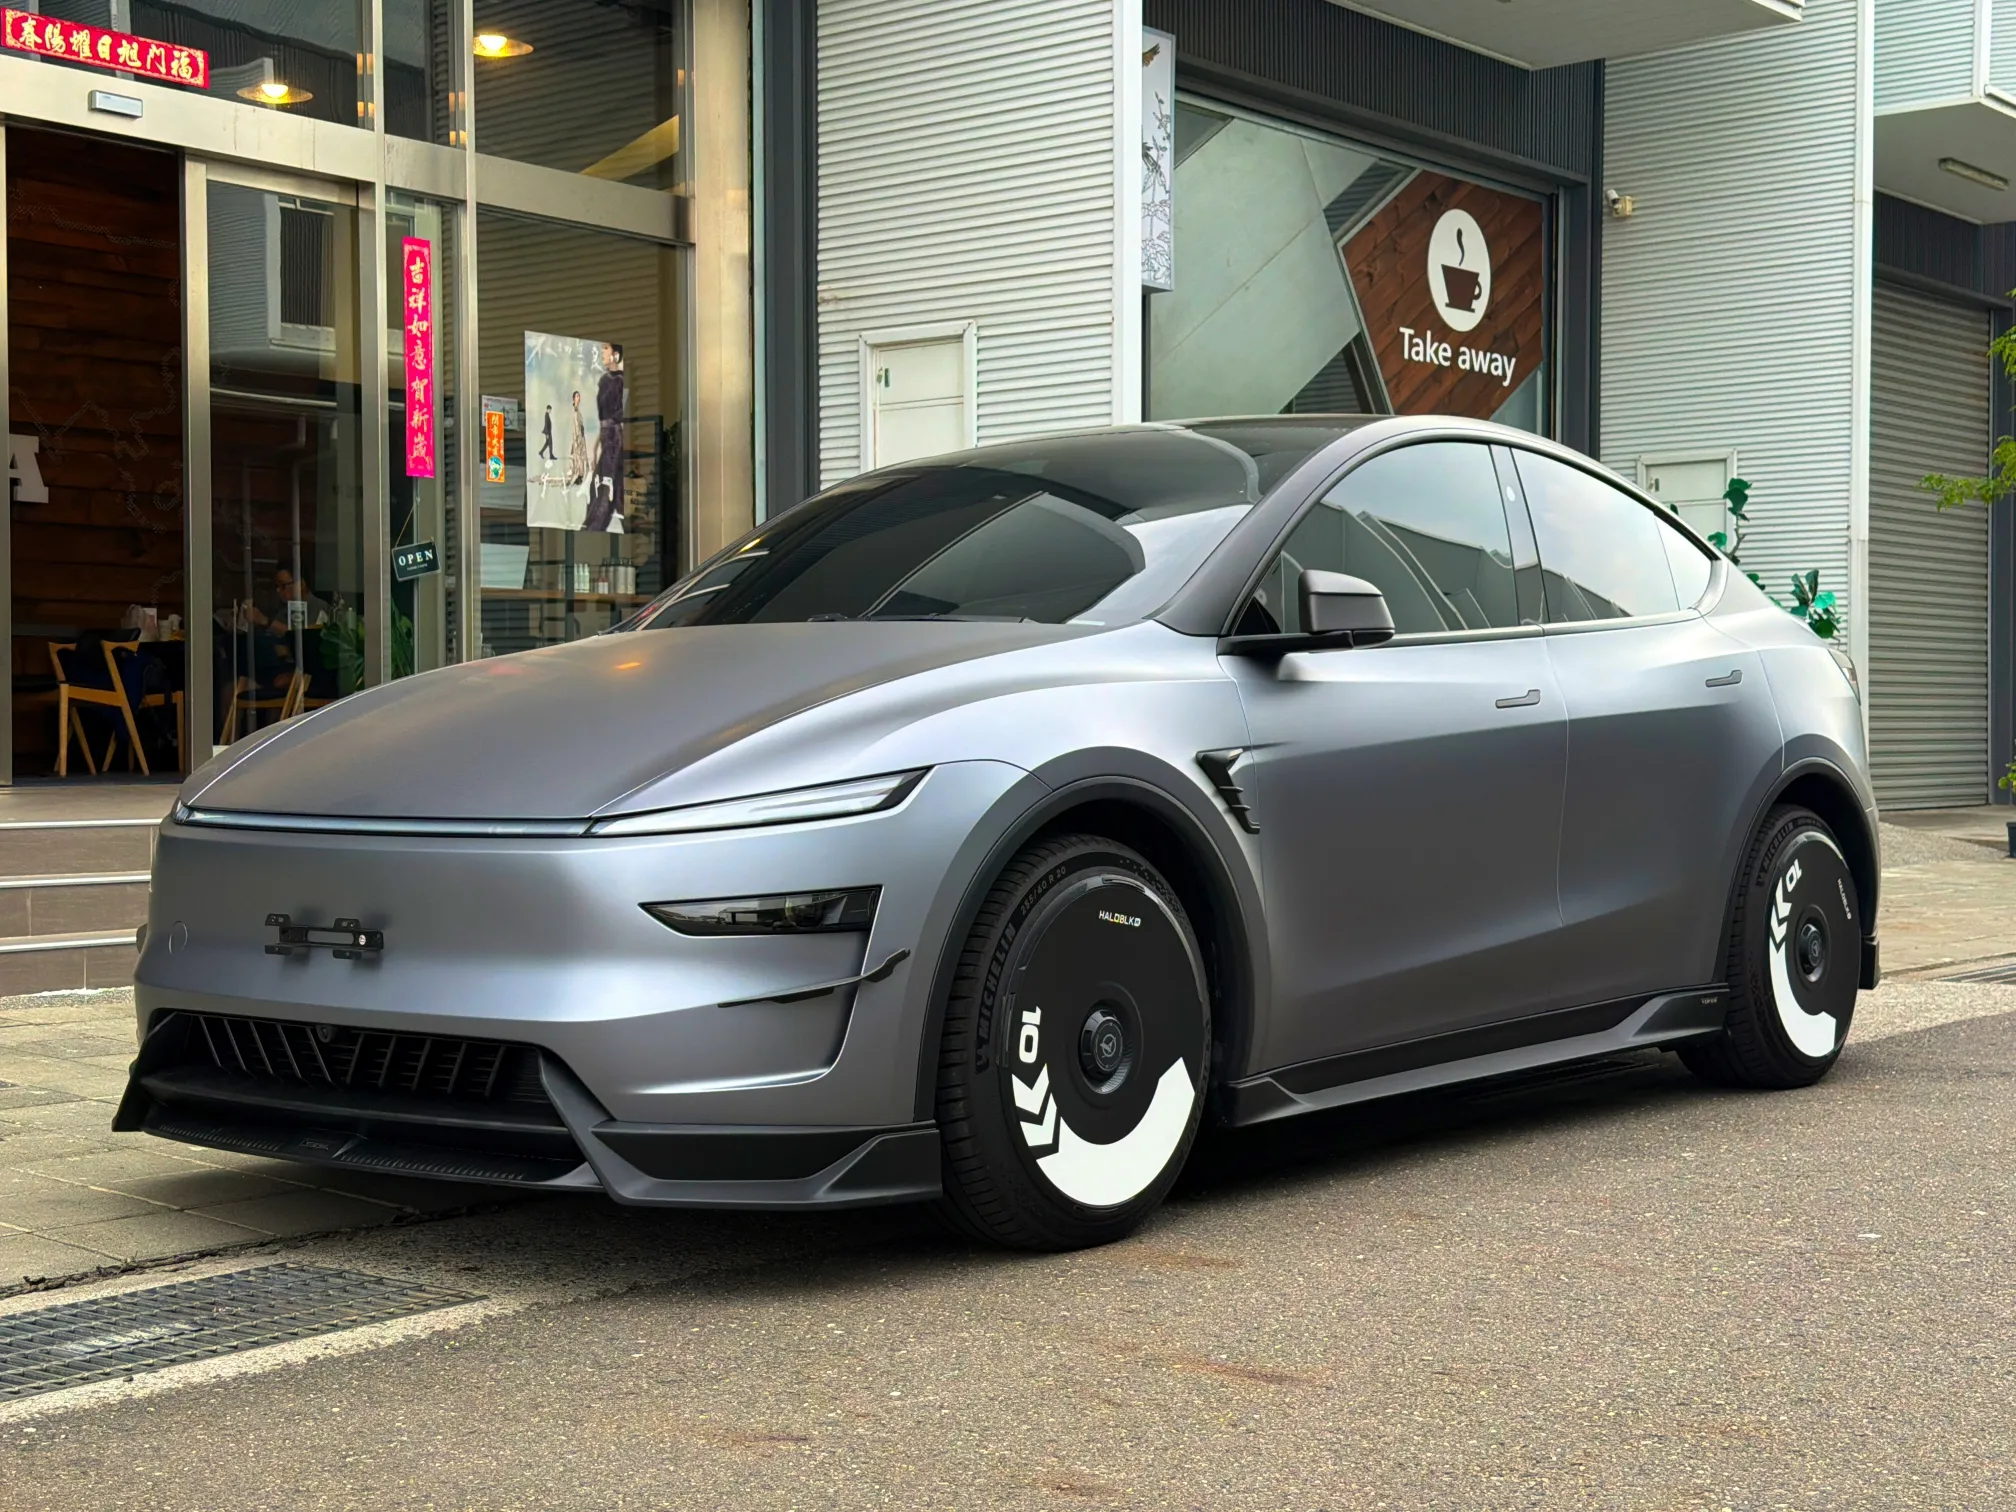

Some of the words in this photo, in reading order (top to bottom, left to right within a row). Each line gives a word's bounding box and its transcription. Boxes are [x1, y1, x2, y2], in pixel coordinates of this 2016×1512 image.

[1399, 326, 1452, 367] Take
[1458, 346, 1516, 387] away
[398, 549, 433, 566] OPEN
[977, 921, 1016, 1041] MICHELIN
[1018, 1005, 1042, 1064] 10
